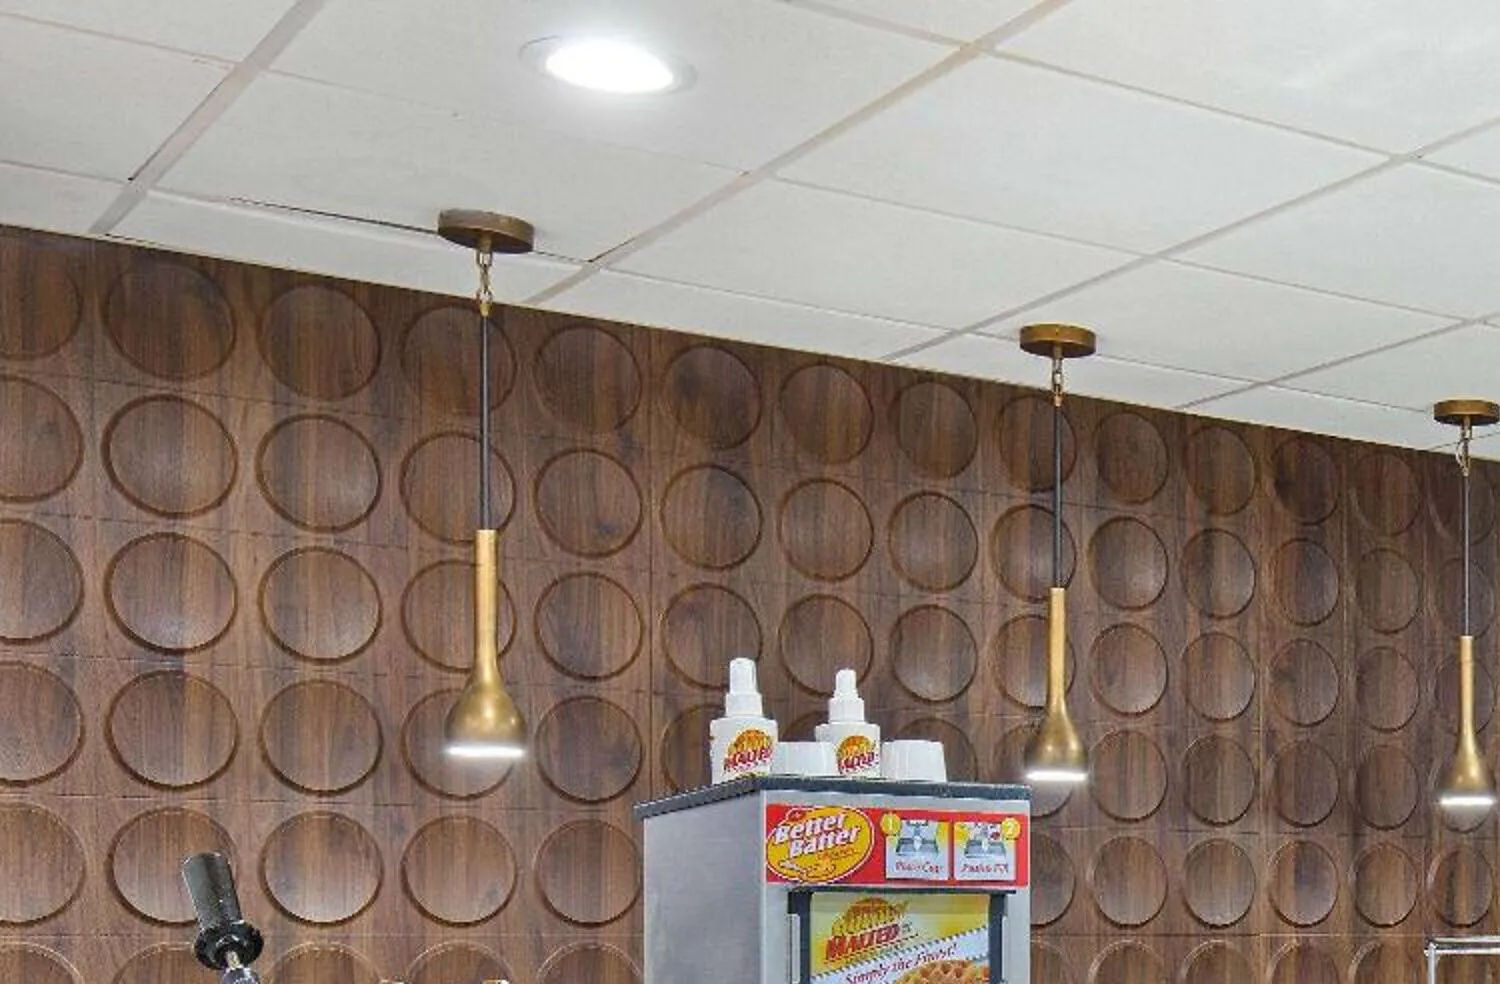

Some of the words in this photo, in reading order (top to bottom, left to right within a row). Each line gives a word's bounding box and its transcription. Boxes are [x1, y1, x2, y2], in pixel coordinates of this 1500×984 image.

[775, 813, 846, 844] Better
[790, 827, 860, 857] Batter
[826, 923, 900, 960] MALTED
[891, 958, 913, 971] the
